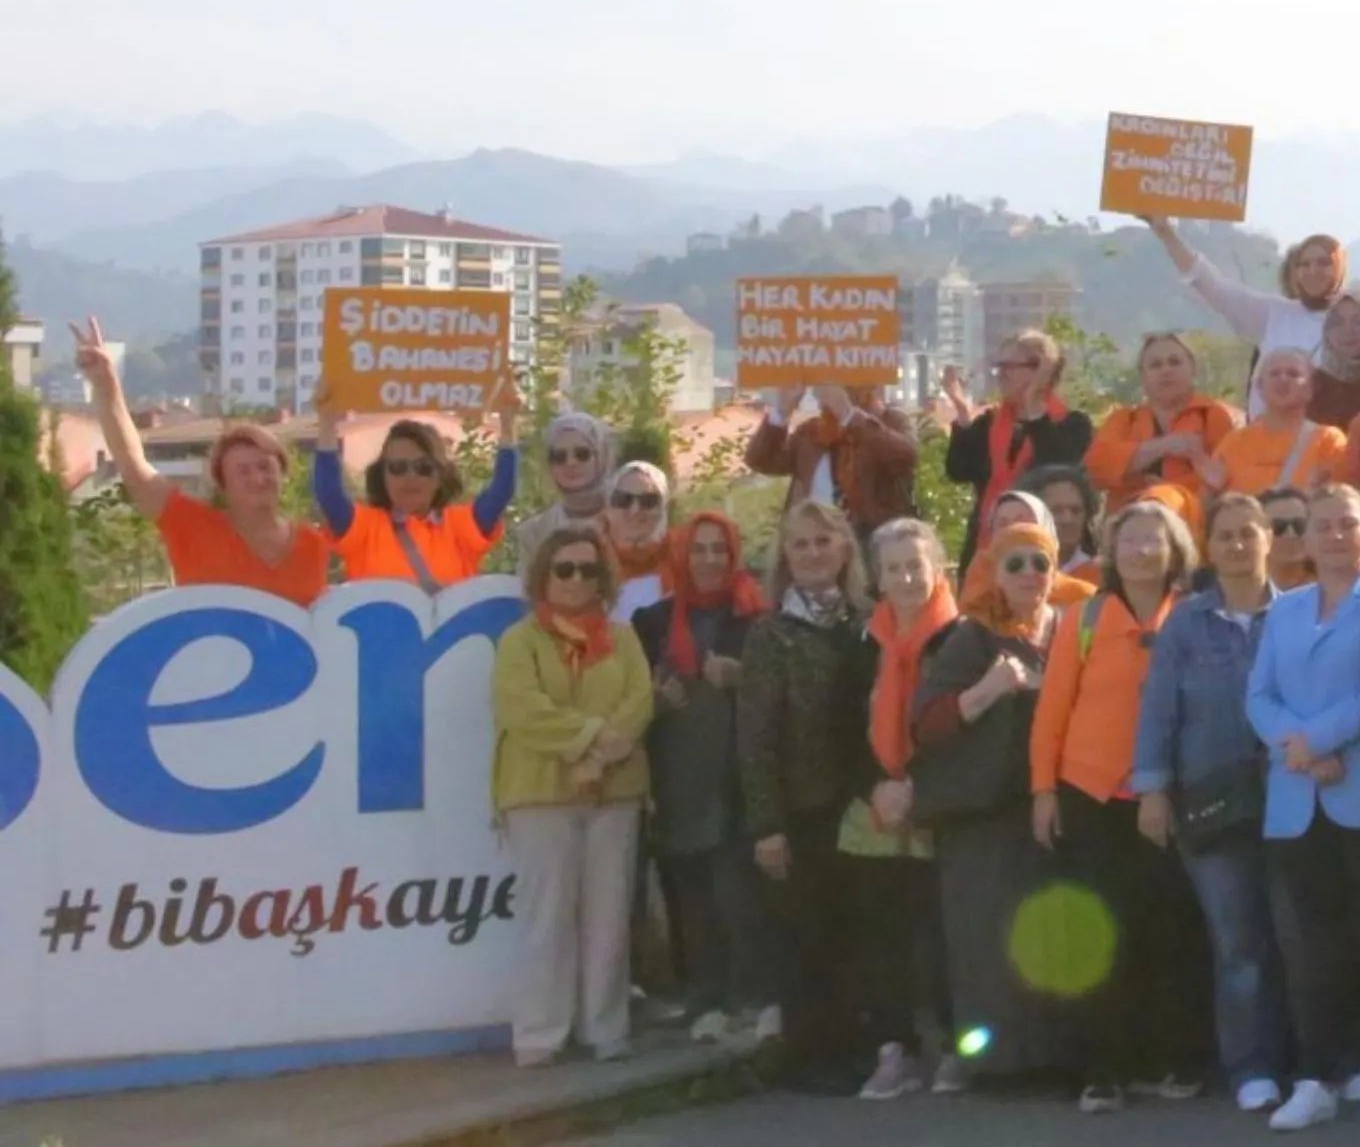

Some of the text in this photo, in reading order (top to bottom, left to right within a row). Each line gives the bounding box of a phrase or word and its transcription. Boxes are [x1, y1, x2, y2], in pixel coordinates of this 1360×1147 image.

[738, 280, 896, 312] HER KADIN
[339, 297, 498, 337] ŞİDDETİN
[796, 316, 880, 342] HAYAT
[350, 339, 502, 373] BAHANESİ
